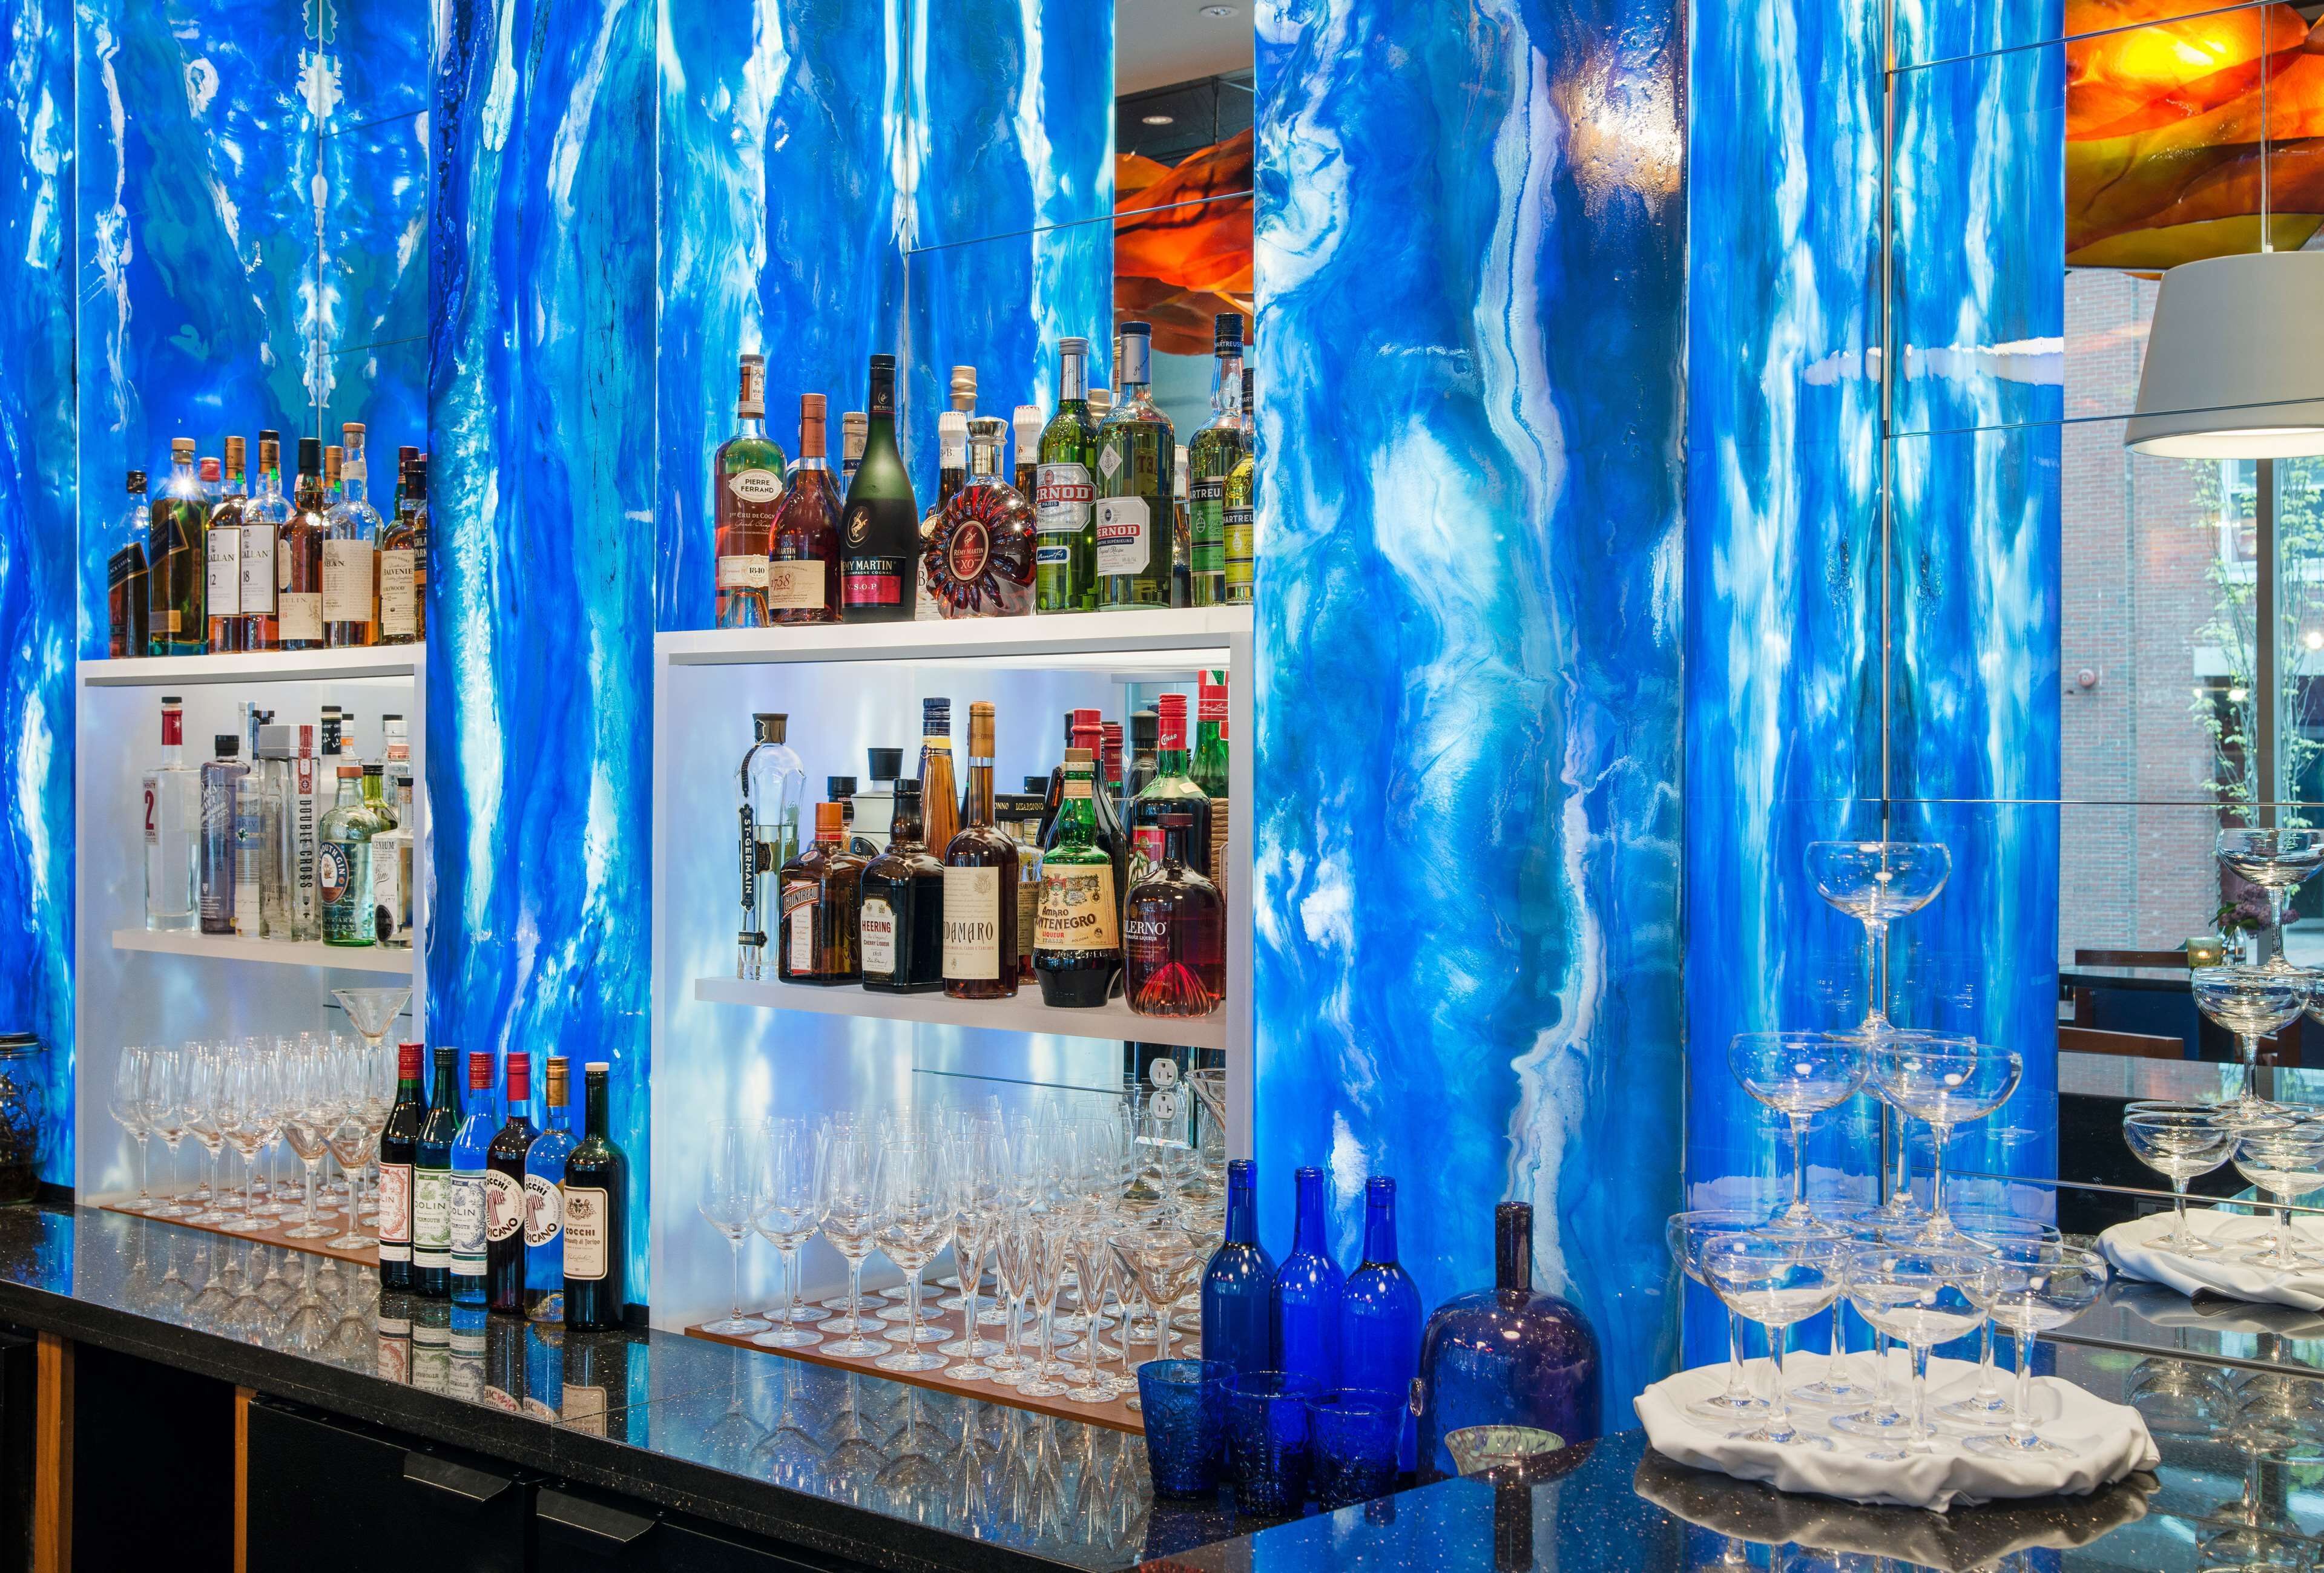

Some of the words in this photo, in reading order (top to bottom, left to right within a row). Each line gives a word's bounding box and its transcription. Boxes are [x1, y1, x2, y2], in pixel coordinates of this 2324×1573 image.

[856, 560, 893, 571] MARTIN
[960, 559, 975, 570] XO
[243, 570, 250, 583] 18
[383, 568, 413, 576] BALVENIE
[209, 573, 217, 586] 12
[771, 573, 791, 591] 1738
[1161, 733, 1177, 746] CYNAR
[144, 789, 155, 830] 2
[1015, 803, 1044, 811] DISARONNO
[299, 799, 313, 844] DOUBLE
[743, 818, 752, 894] ST-GERMAIN
[299, 850, 313, 889] CROSS
[336, 856, 346, 875] GIN
[784, 887, 818, 913] COINTREAU
[1042, 905, 1069, 918] AMARO
[861, 920, 892, 933] HEERING
[487, 1178, 509, 1192] OCCHI
[525, 1182, 548, 1197] OCCHI
[565, 1227, 595, 1236] COCCHI
